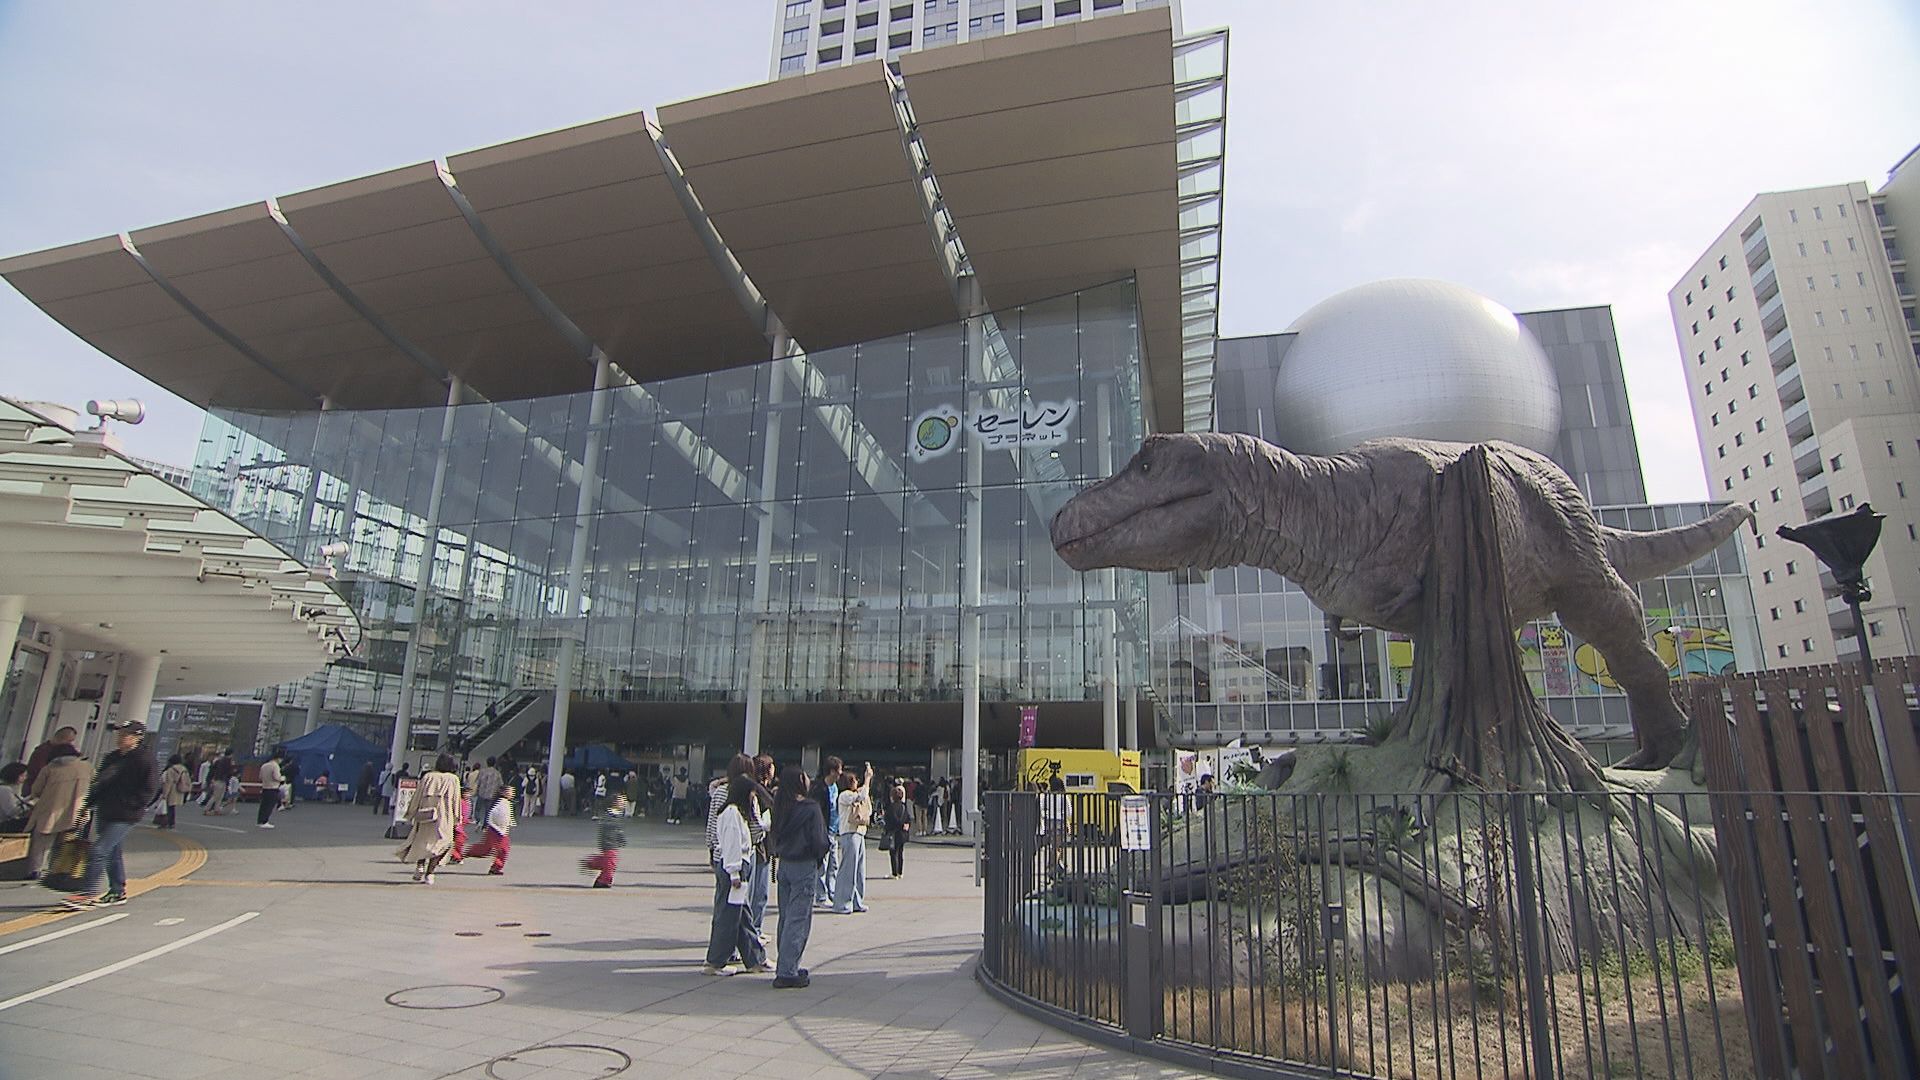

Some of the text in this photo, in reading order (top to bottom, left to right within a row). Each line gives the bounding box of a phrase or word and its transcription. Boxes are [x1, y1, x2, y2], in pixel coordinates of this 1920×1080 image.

[973, 406, 1070, 433] セーレン
[988, 431, 1061, 444] プラネット
